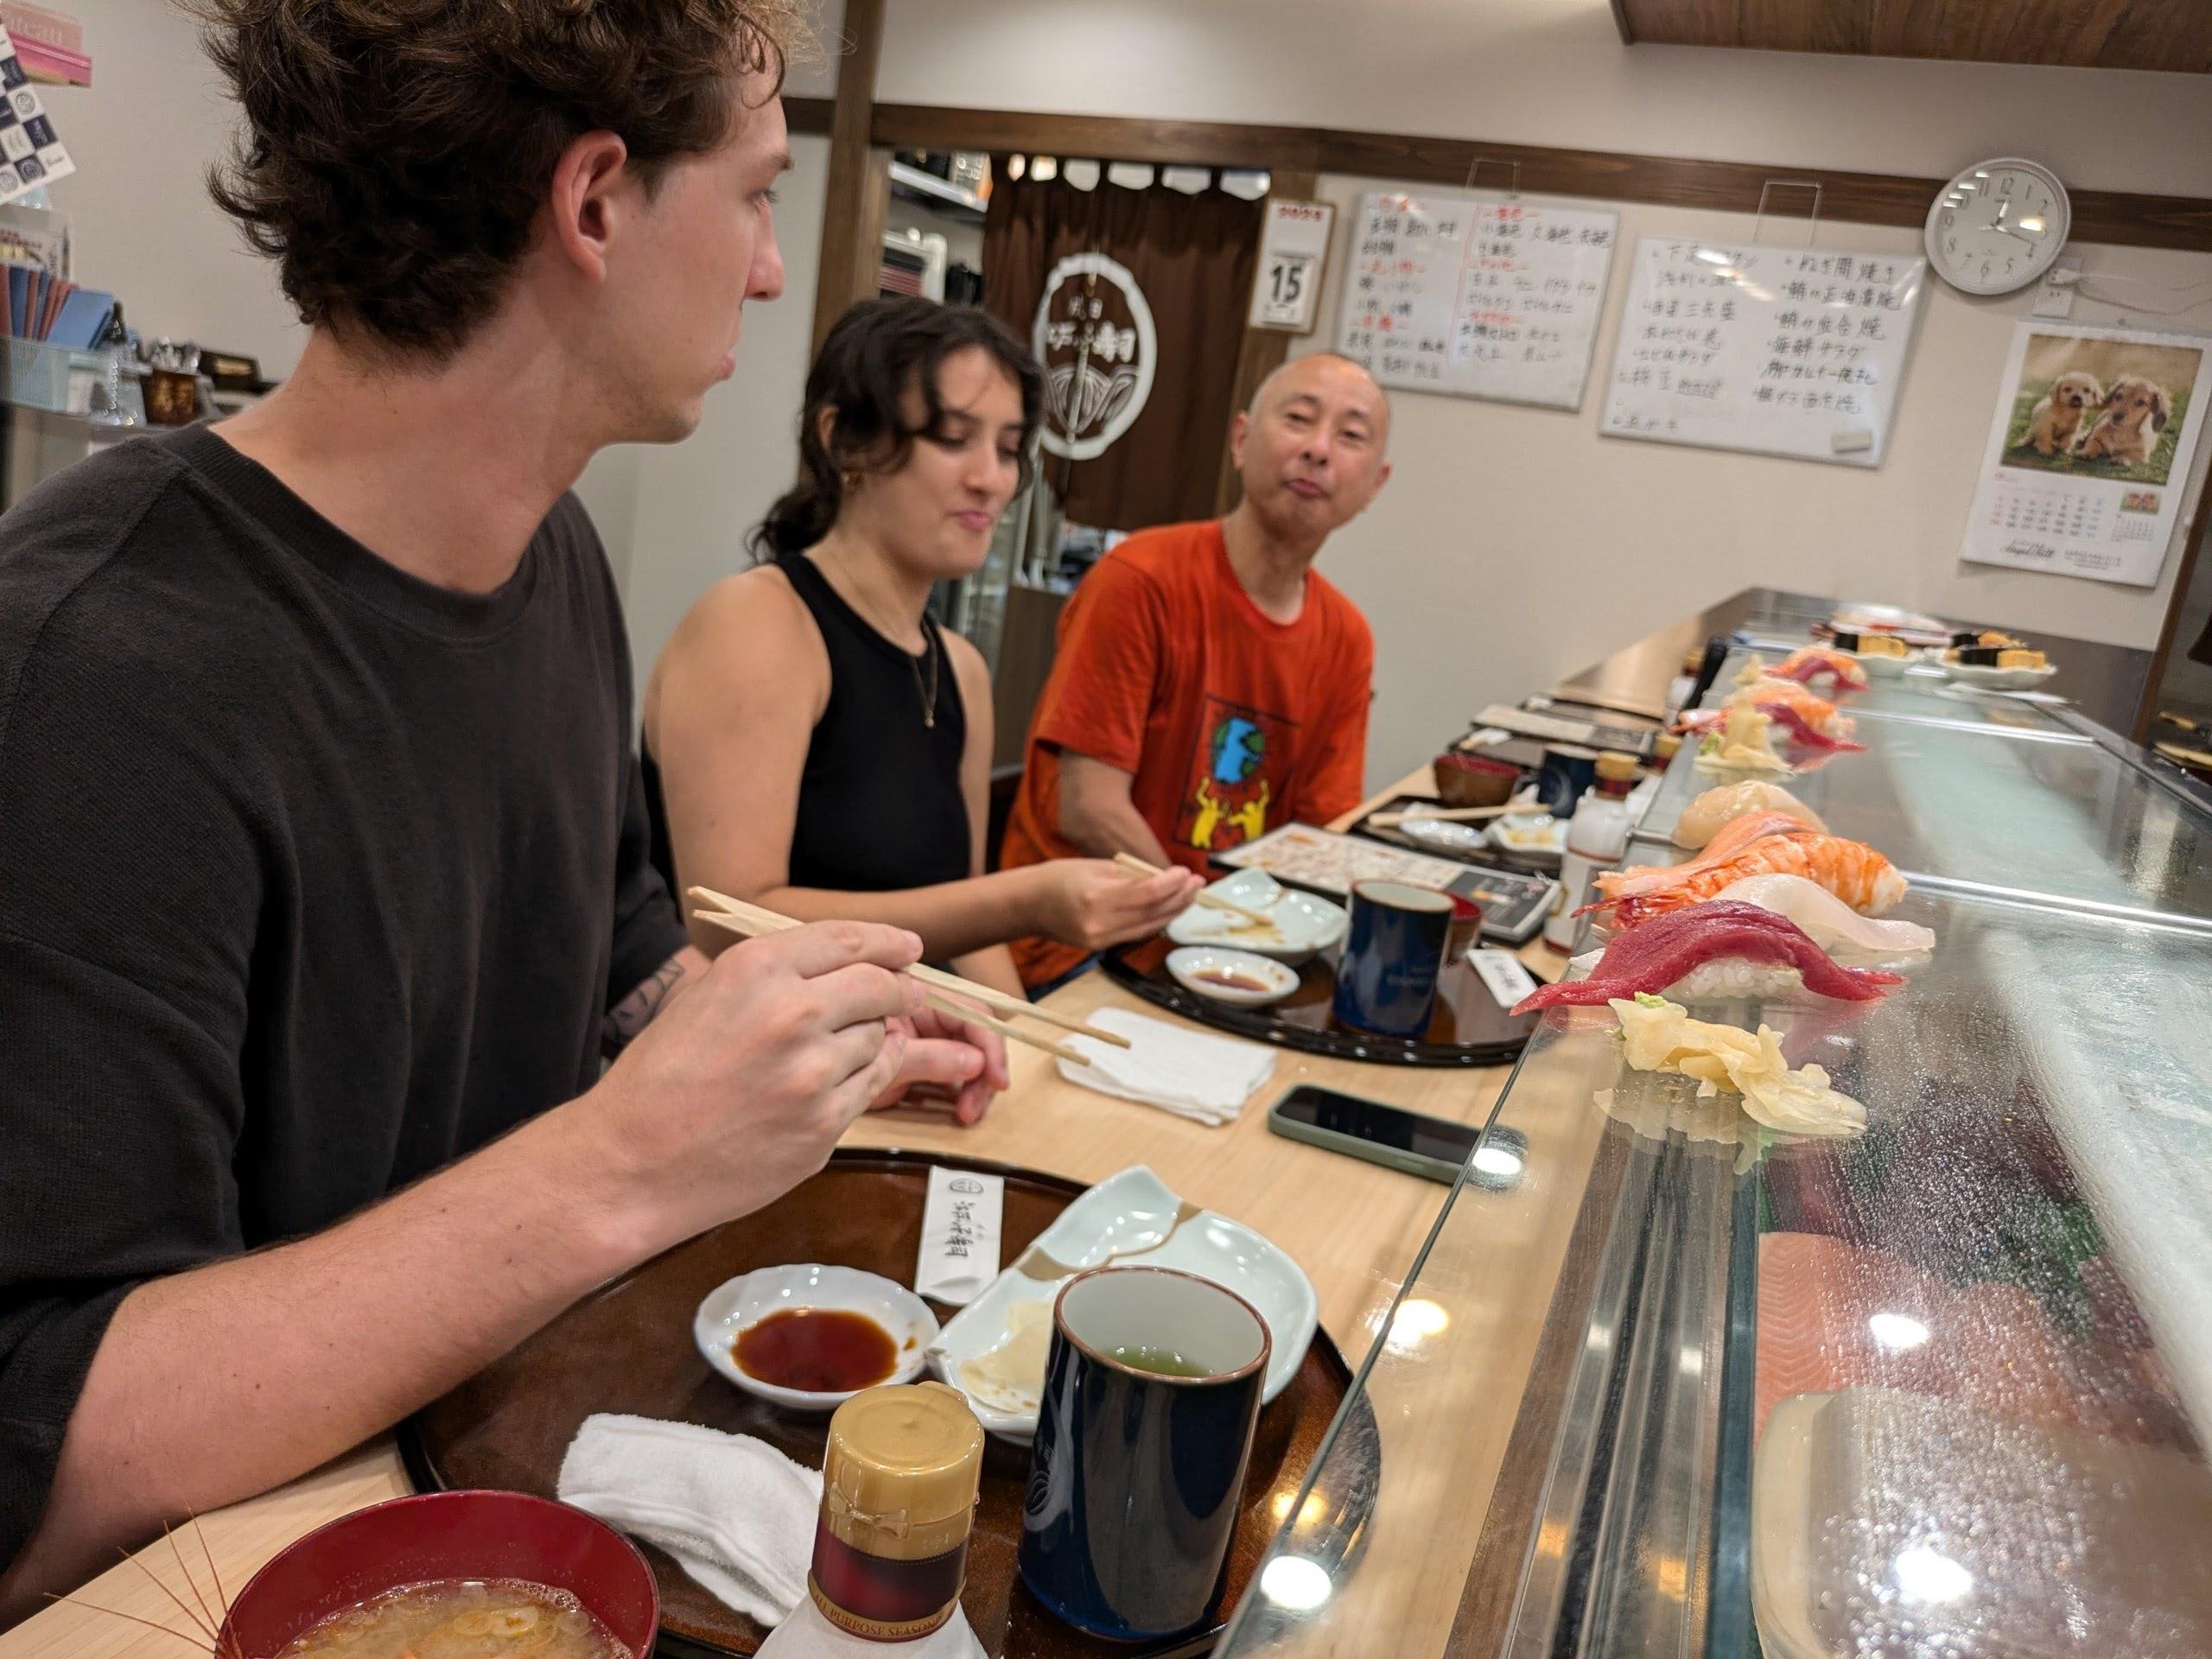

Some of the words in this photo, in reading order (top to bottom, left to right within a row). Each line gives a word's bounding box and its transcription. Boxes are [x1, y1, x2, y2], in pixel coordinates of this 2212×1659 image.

[1271, 264, 1302, 303] 15
[815, 1593, 829, 1611] ALL
[830, 1608, 886, 1637] PURPOSE
